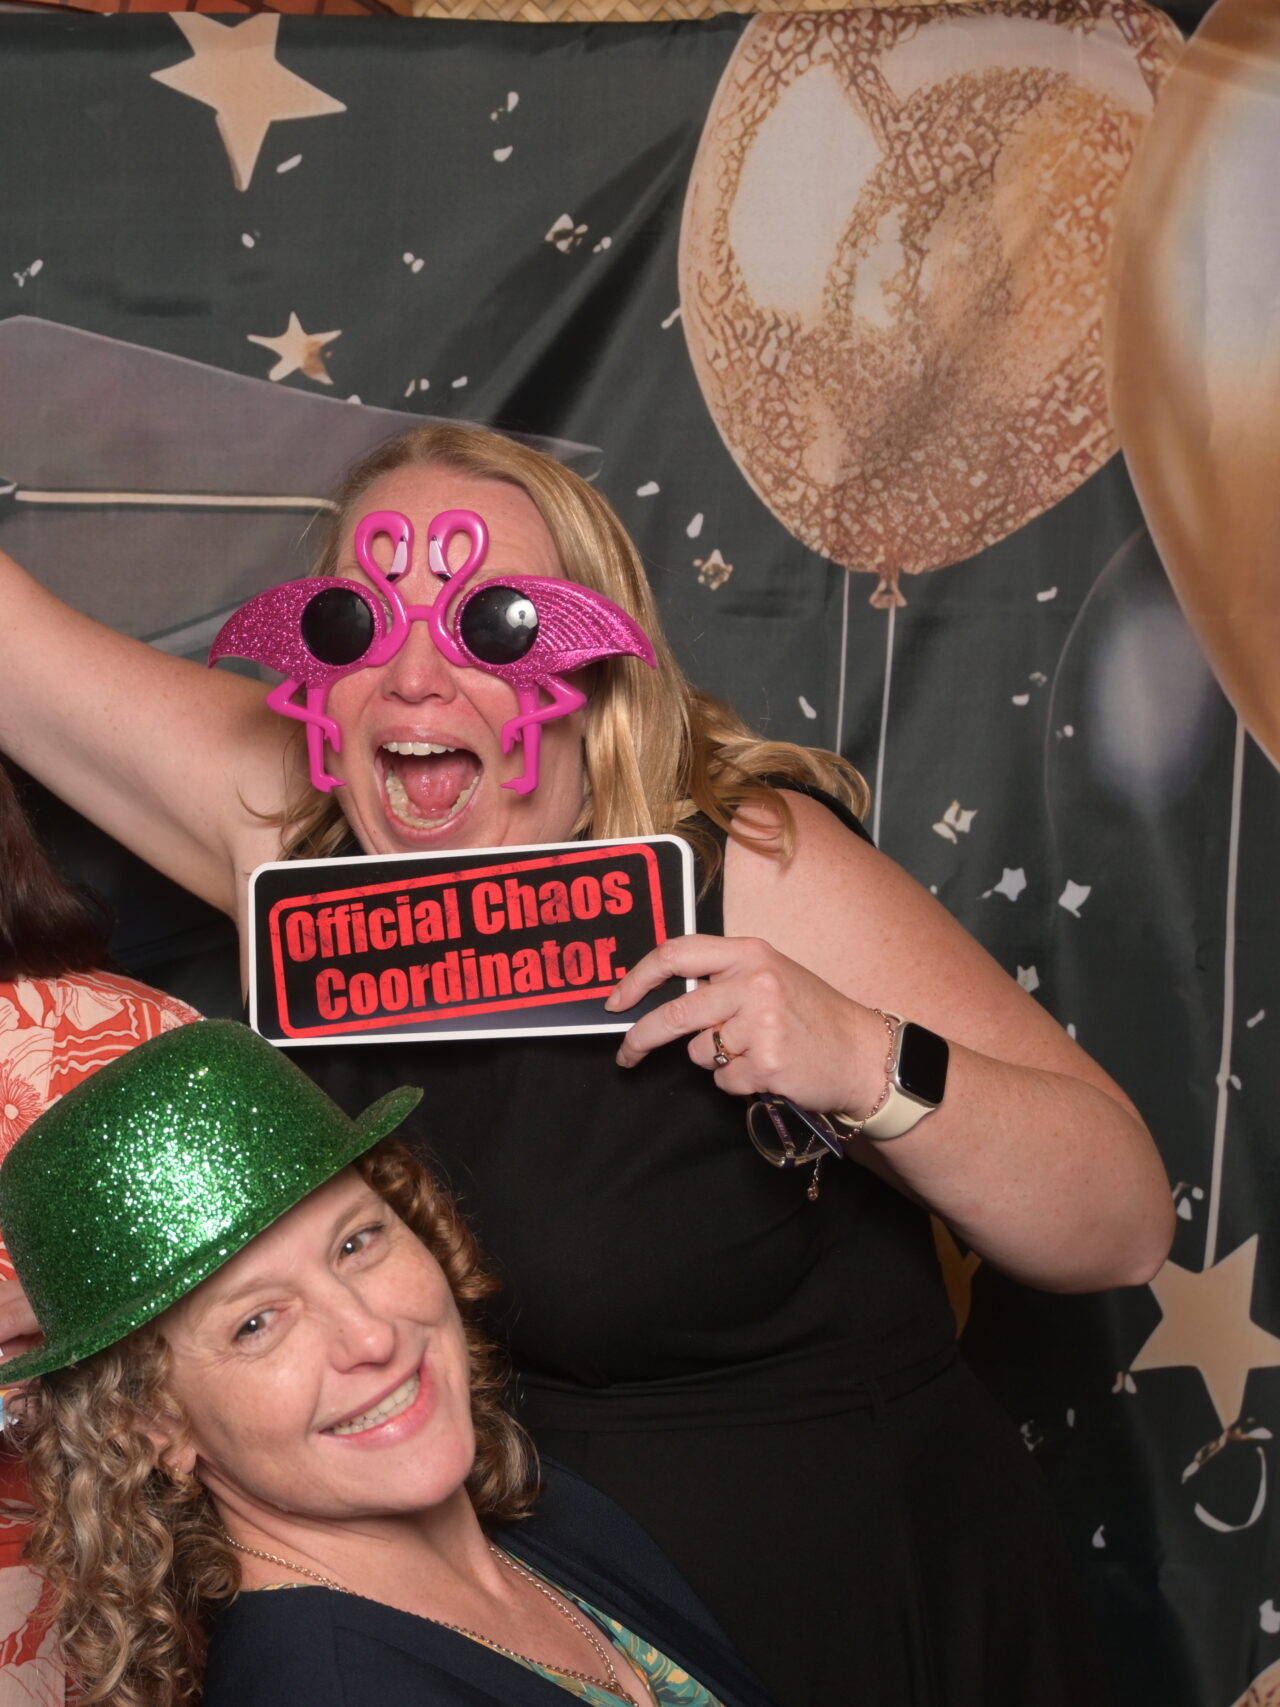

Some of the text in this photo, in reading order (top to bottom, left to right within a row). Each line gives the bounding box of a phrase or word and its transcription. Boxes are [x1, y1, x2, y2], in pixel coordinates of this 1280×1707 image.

[285, 870, 634, 963] Official Chaos
[315, 933, 627, 1020] Coordinator.
